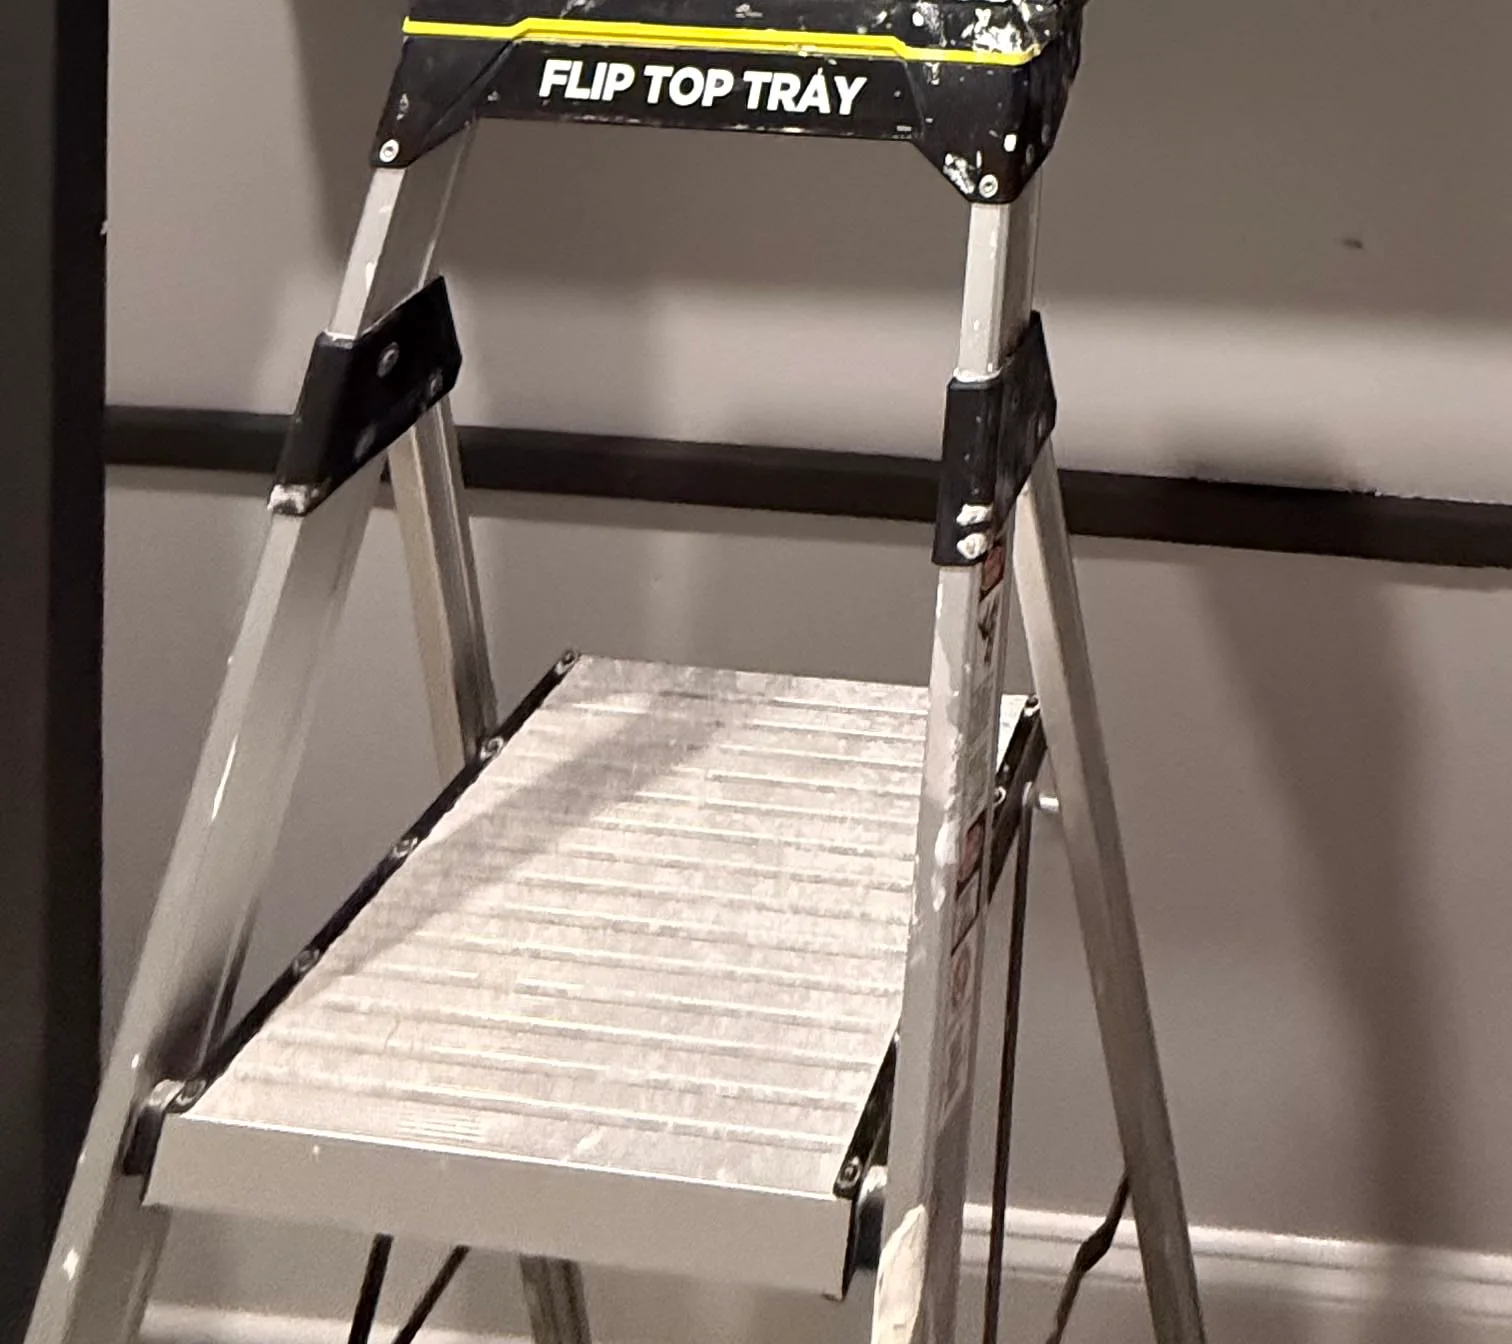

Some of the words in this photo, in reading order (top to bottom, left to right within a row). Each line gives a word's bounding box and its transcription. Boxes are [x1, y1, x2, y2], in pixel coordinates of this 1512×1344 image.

[538, 59, 635, 102] FLIP
[643, 64, 735, 107] TOP
[743, 69, 867, 115] TRAY
